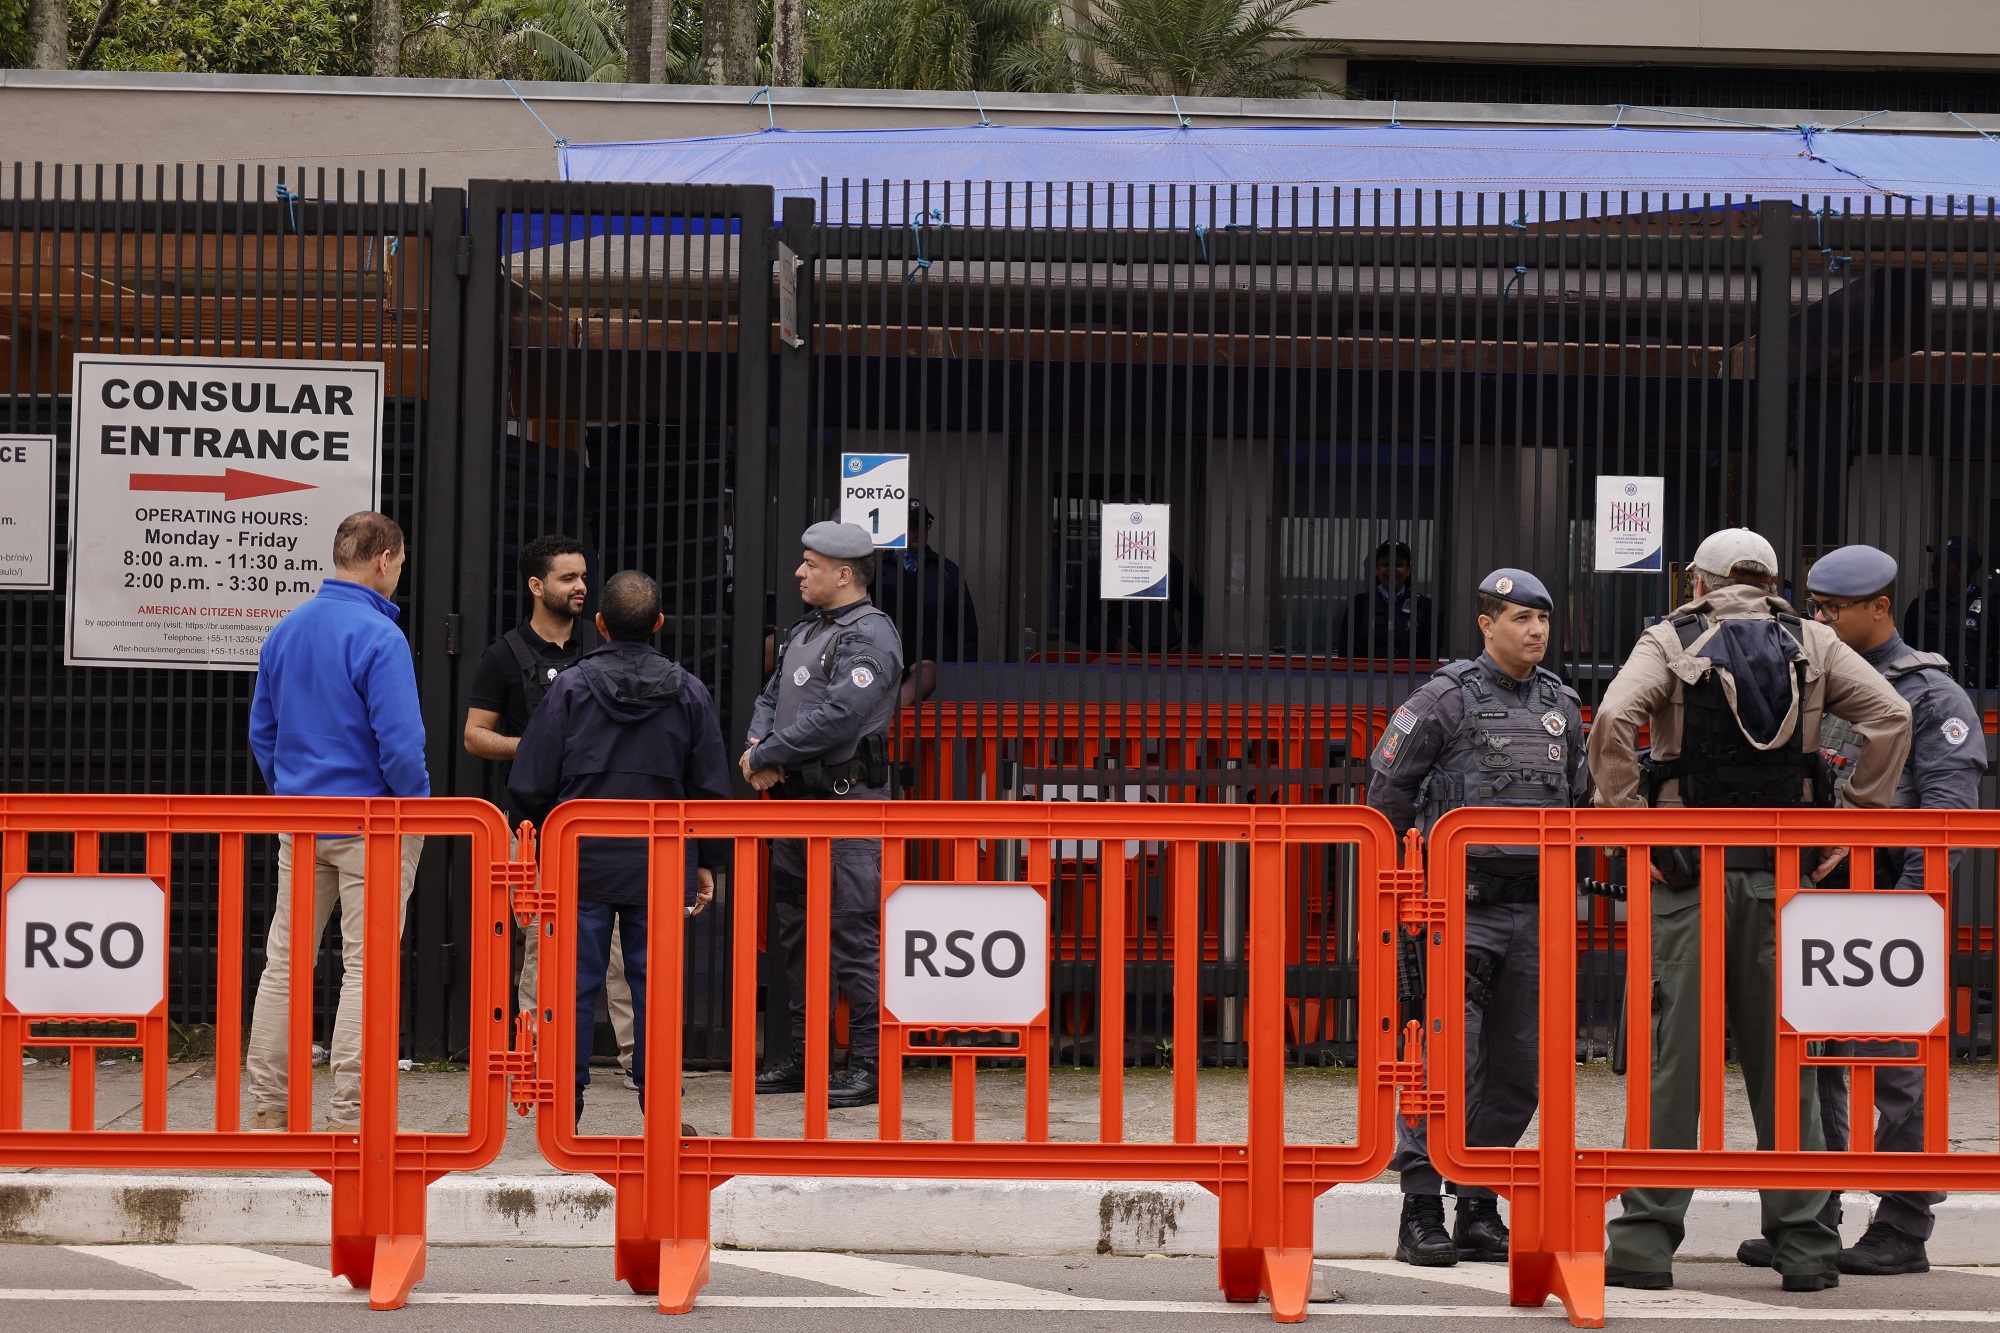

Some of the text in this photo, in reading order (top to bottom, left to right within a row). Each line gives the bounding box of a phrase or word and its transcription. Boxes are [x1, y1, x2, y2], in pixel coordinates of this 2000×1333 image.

[101, 378, 354, 415] CONSULAR
[100, 425, 349, 462] ENTRANCE
[847, 485, 905, 499] PORTÃO
[135, 508, 308, 526] OPERATING HOURS:
[868, 508, 879, 534] 1
[145, 529, 219, 549] Monday
[238, 532, 298, 551] Friday
[124, 550, 163, 566] 8:00
[169, 555, 208, 567] a.m.
[227, 553, 278, 570] 11:30
[284, 558, 323, 571] a.m.
[124, 572, 163, 588] 2:00
[170, 577, 209, 592] p.m.
[229, 576, 269, 591] 3:30
[275, 580, 315, 595] p.m.
[138, 606, 197, 616] AMERICAN
[200, 608, 242, 618] CITIZEN
[85, 619, 94, 628] by
[96, 620, 143, 629] appointment
[146, 621, 161, 630] only
[164, 622, 183, 631] (visit:
[163, 634, 204, 643] Telephone:
[113, 645, 208, 656] After-hours/emergencies:
[24, 921, 144, 968] RSO
[904, 929, 1026, 978] RSO
[1801, 938, 1925, 987] RSO
